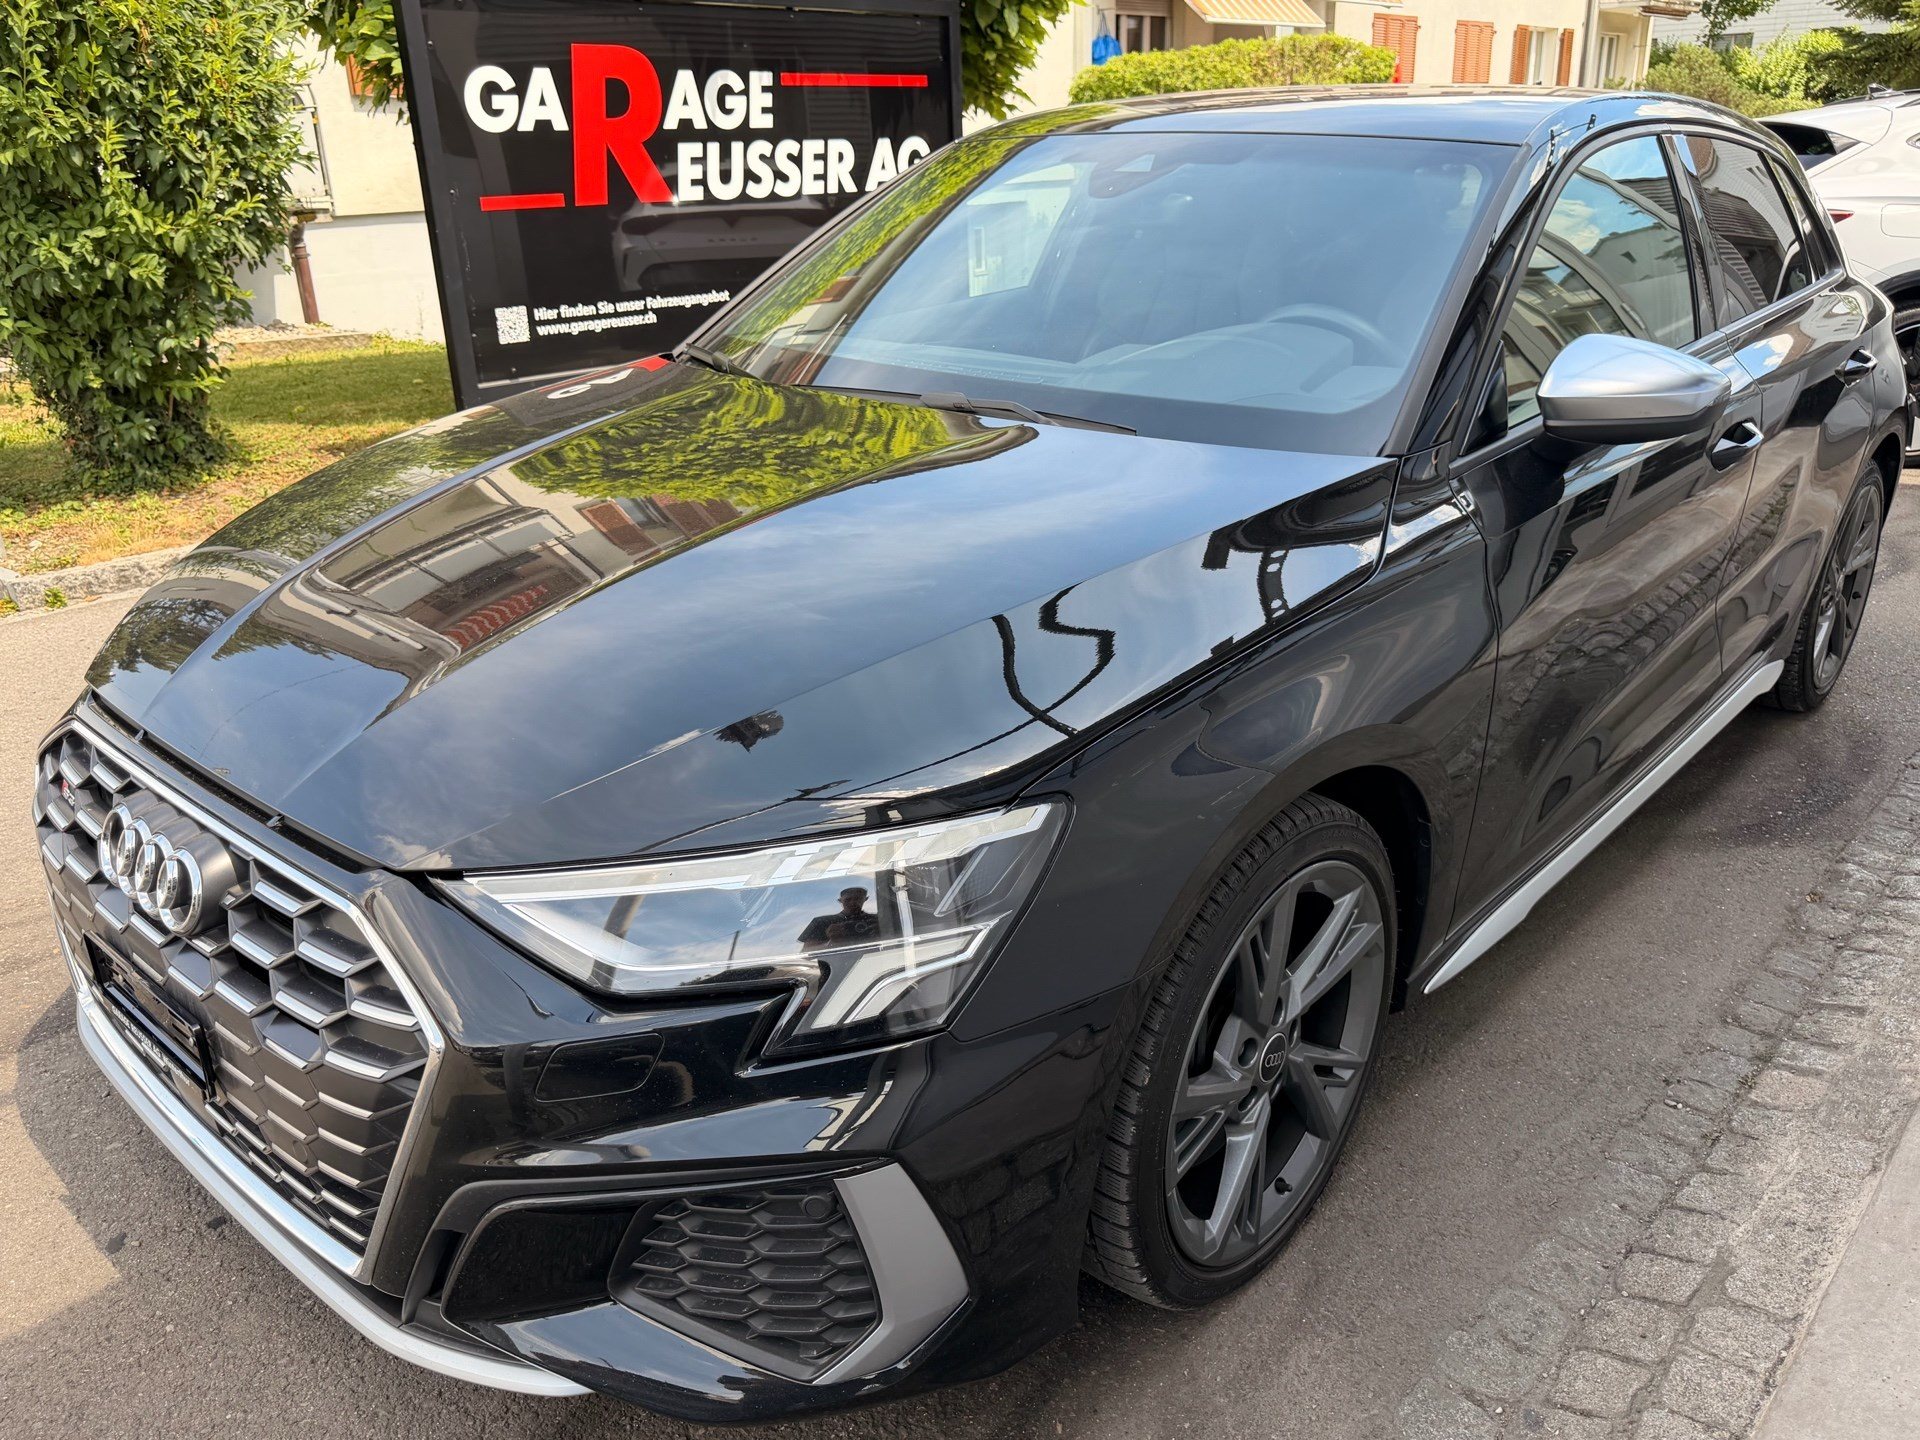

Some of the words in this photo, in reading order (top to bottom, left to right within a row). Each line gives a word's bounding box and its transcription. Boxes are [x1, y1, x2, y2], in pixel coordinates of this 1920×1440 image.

[463, 43, 774, 207] GARAGE
[865, 135, 931, 192] AG
[533, 306, 559, 321] Hier
[559, 302, 597, 318] finden
[597, 300, 615, 314] Sie
[615, 299, 645, 312] unser
[645, 289, 731, 308] Fahrzeugangebot
[536, 310, 658, 336] www.garagereusser.ch
